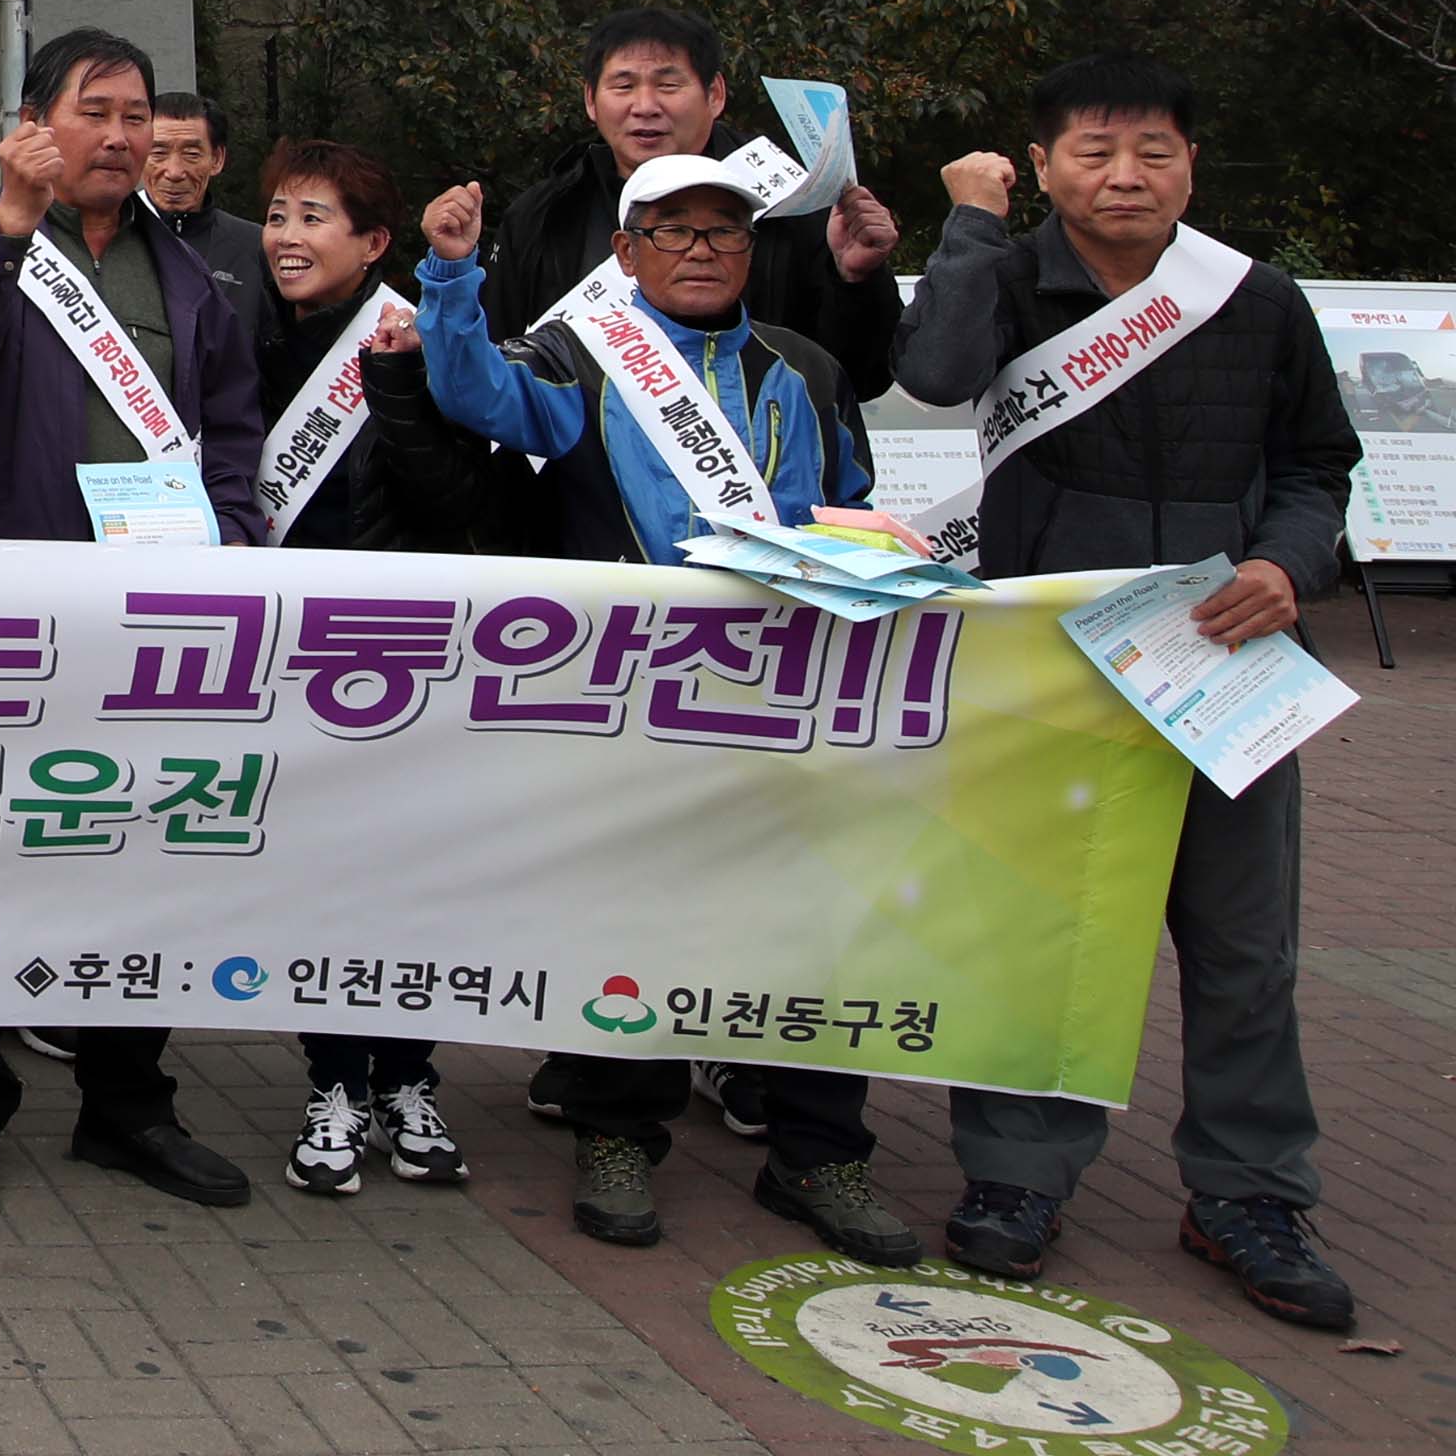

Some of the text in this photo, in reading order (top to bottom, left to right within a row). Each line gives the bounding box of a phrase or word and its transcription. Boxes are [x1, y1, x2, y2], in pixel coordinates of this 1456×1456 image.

[588, 310, 682, 399] 난폭운전
[1060, 294, 1183, 392] 음주운전
[1351, 312, 1408, 326] 현장사진 14
[89, 329, 172, 440] 평생눈물
[1074, 610, 1104, 631] Peace
[1116, 594, 1134, 608] the
[1133, 581, 1160, 599] Road
[101, 589, 950, 742] 교통안전!!
[62, 952, 162, 1002] 후원
[287, 957, 549, 1022] 인천광역시
[665, 985, 942, 1054] 인천동구청
[725, 1258, 875, 1348] Walking Trail
